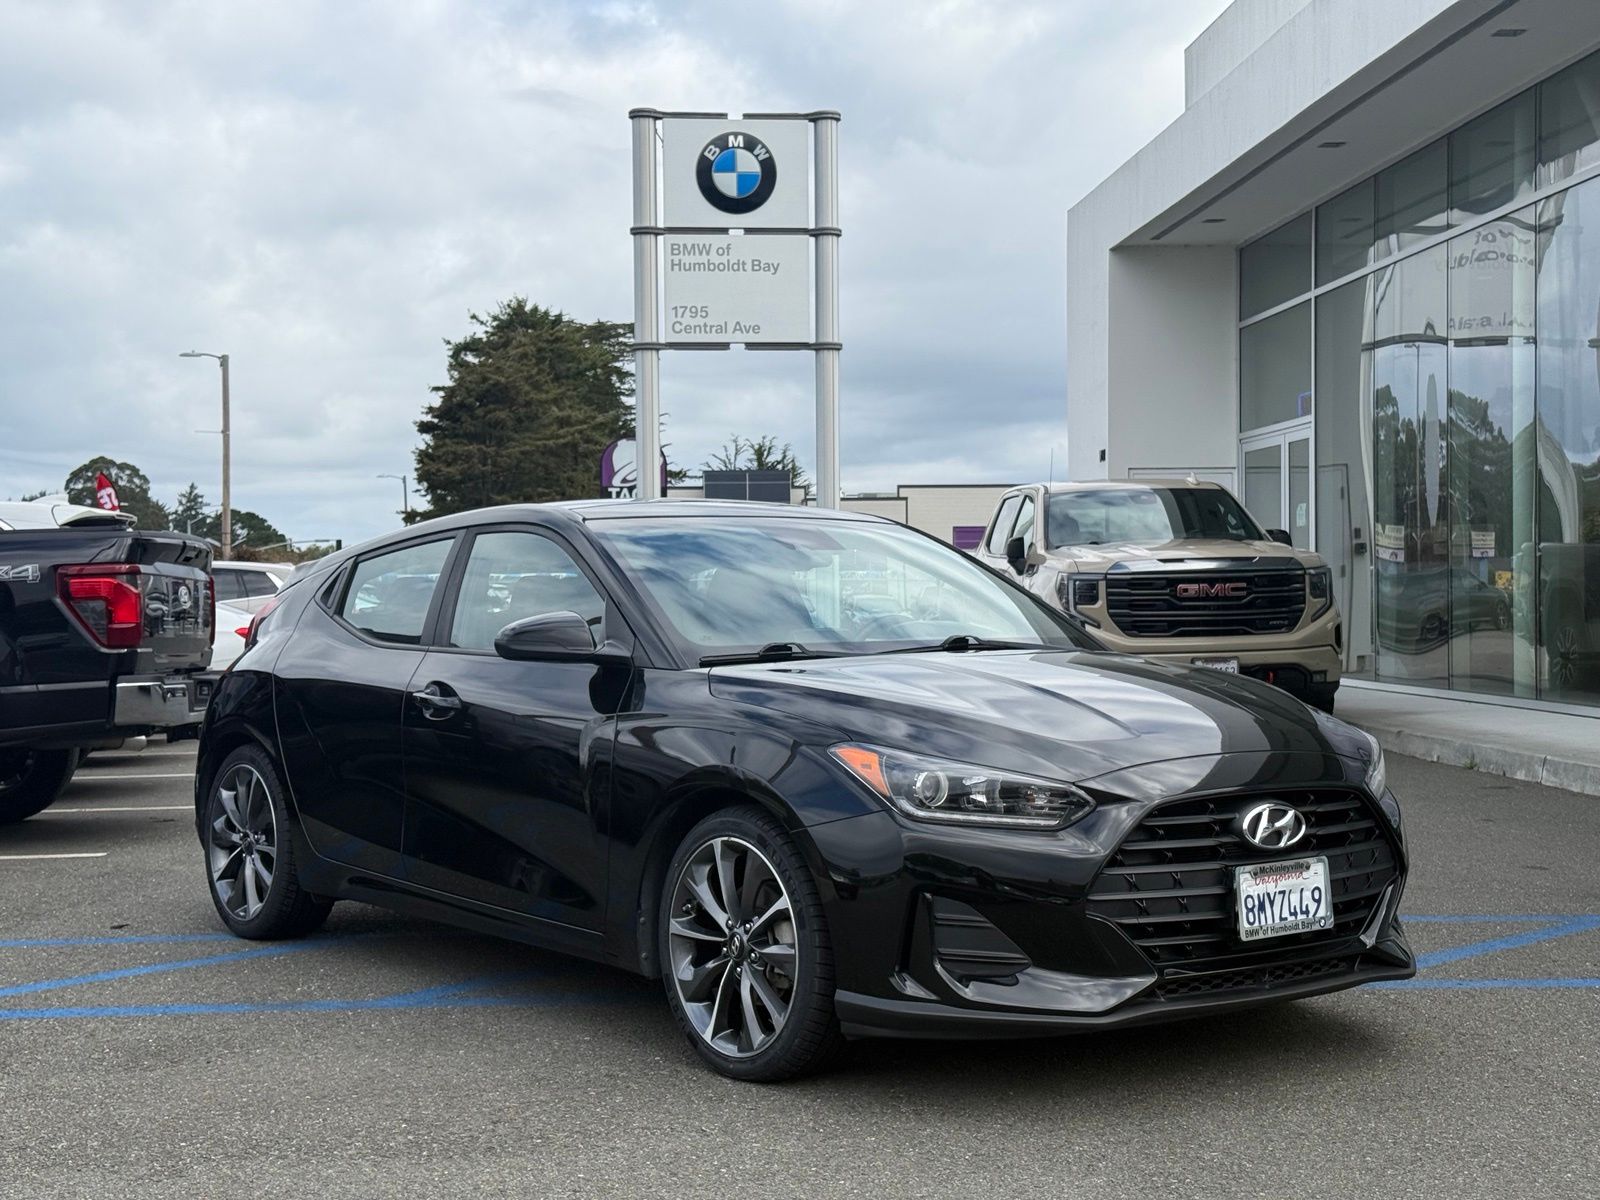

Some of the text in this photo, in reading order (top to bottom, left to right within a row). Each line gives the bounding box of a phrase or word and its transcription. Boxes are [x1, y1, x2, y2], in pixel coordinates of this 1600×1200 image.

[704, 135, 770, 162] BMW
[670, 243, 732, 256] BMW of
[670, 259, 780, 275] Humboldt Bay
[671, 305, 709, 319] 1795
[671, 321, 761, 334] Central Ave
[1177, 583, 1247, 597] GMC
[1259, 862, 1304, 874] McKinleyville
[1244, 886, 1322, 926] 8MYZ449
[1244, 920, 1313, 938] BMW of Humboldt Bay
